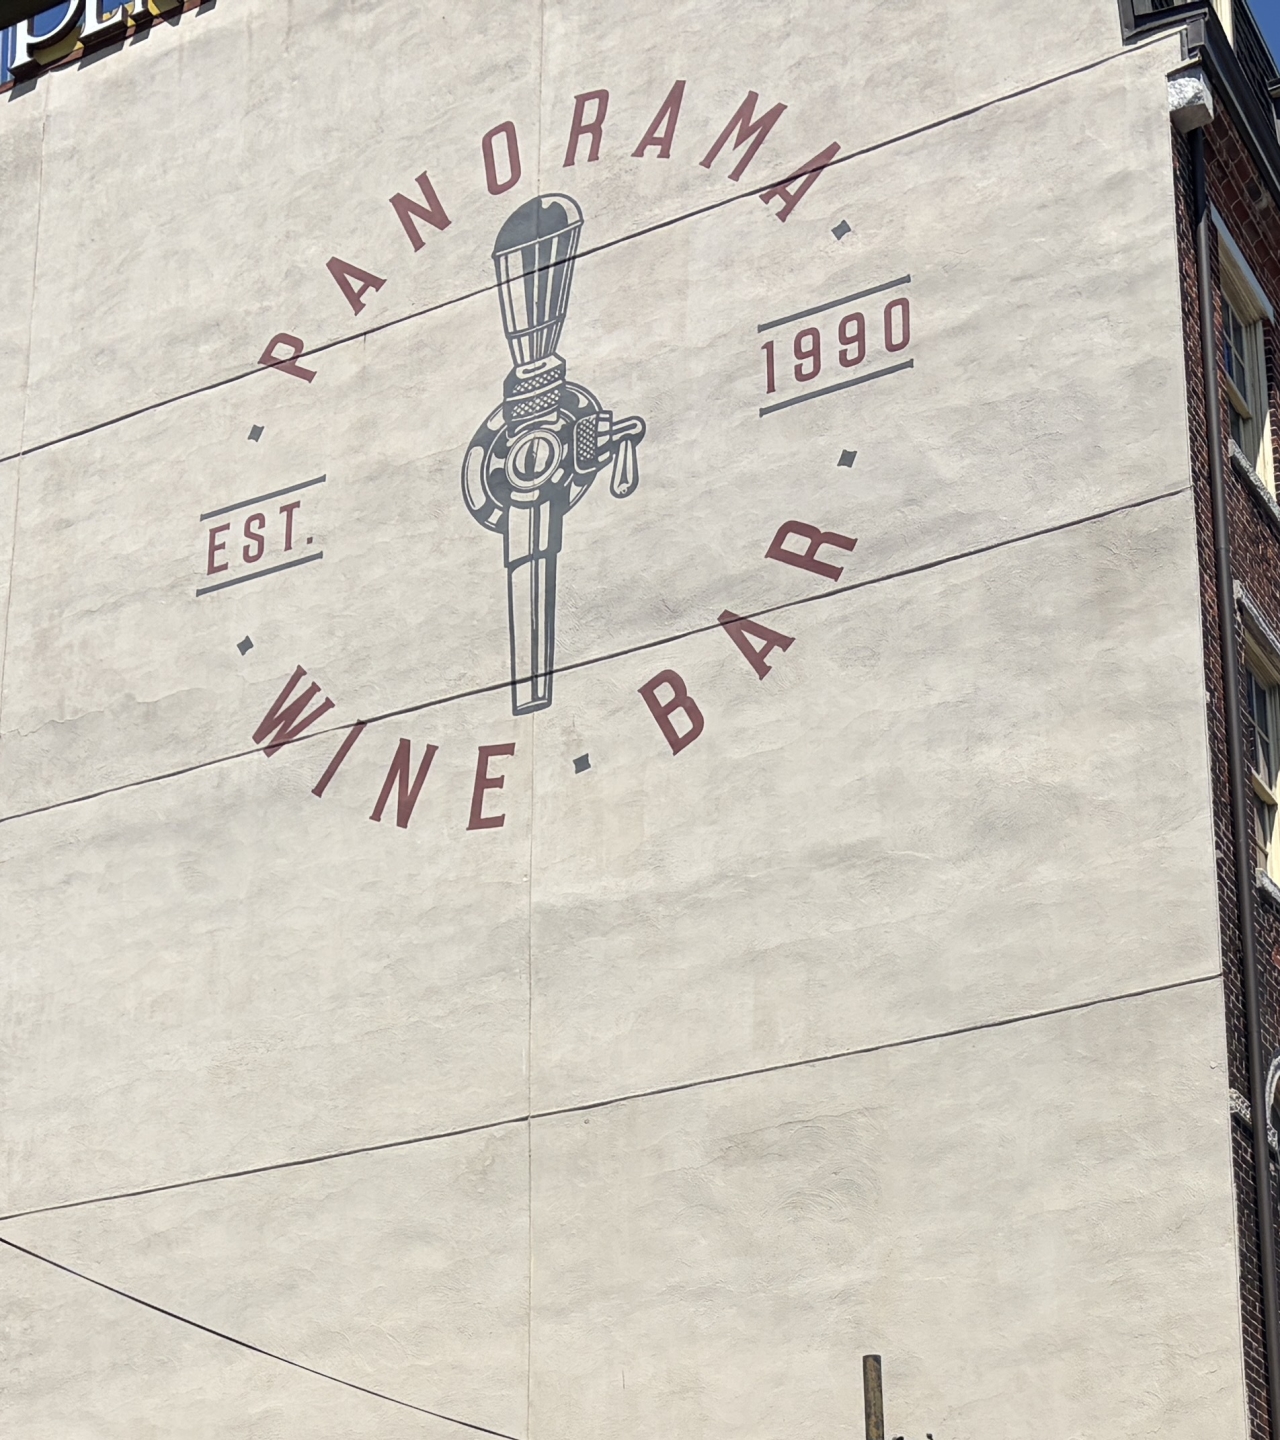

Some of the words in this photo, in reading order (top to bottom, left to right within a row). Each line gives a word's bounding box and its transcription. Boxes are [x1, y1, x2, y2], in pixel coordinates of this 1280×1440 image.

[258, 79, 841, 382] PANORAMA
[760, 296, 912, 395] 1990
[203, 501, 314, 577] EST.
[251, 663, 517, 831] WINE
[636, 517, 858, 756] BAR
